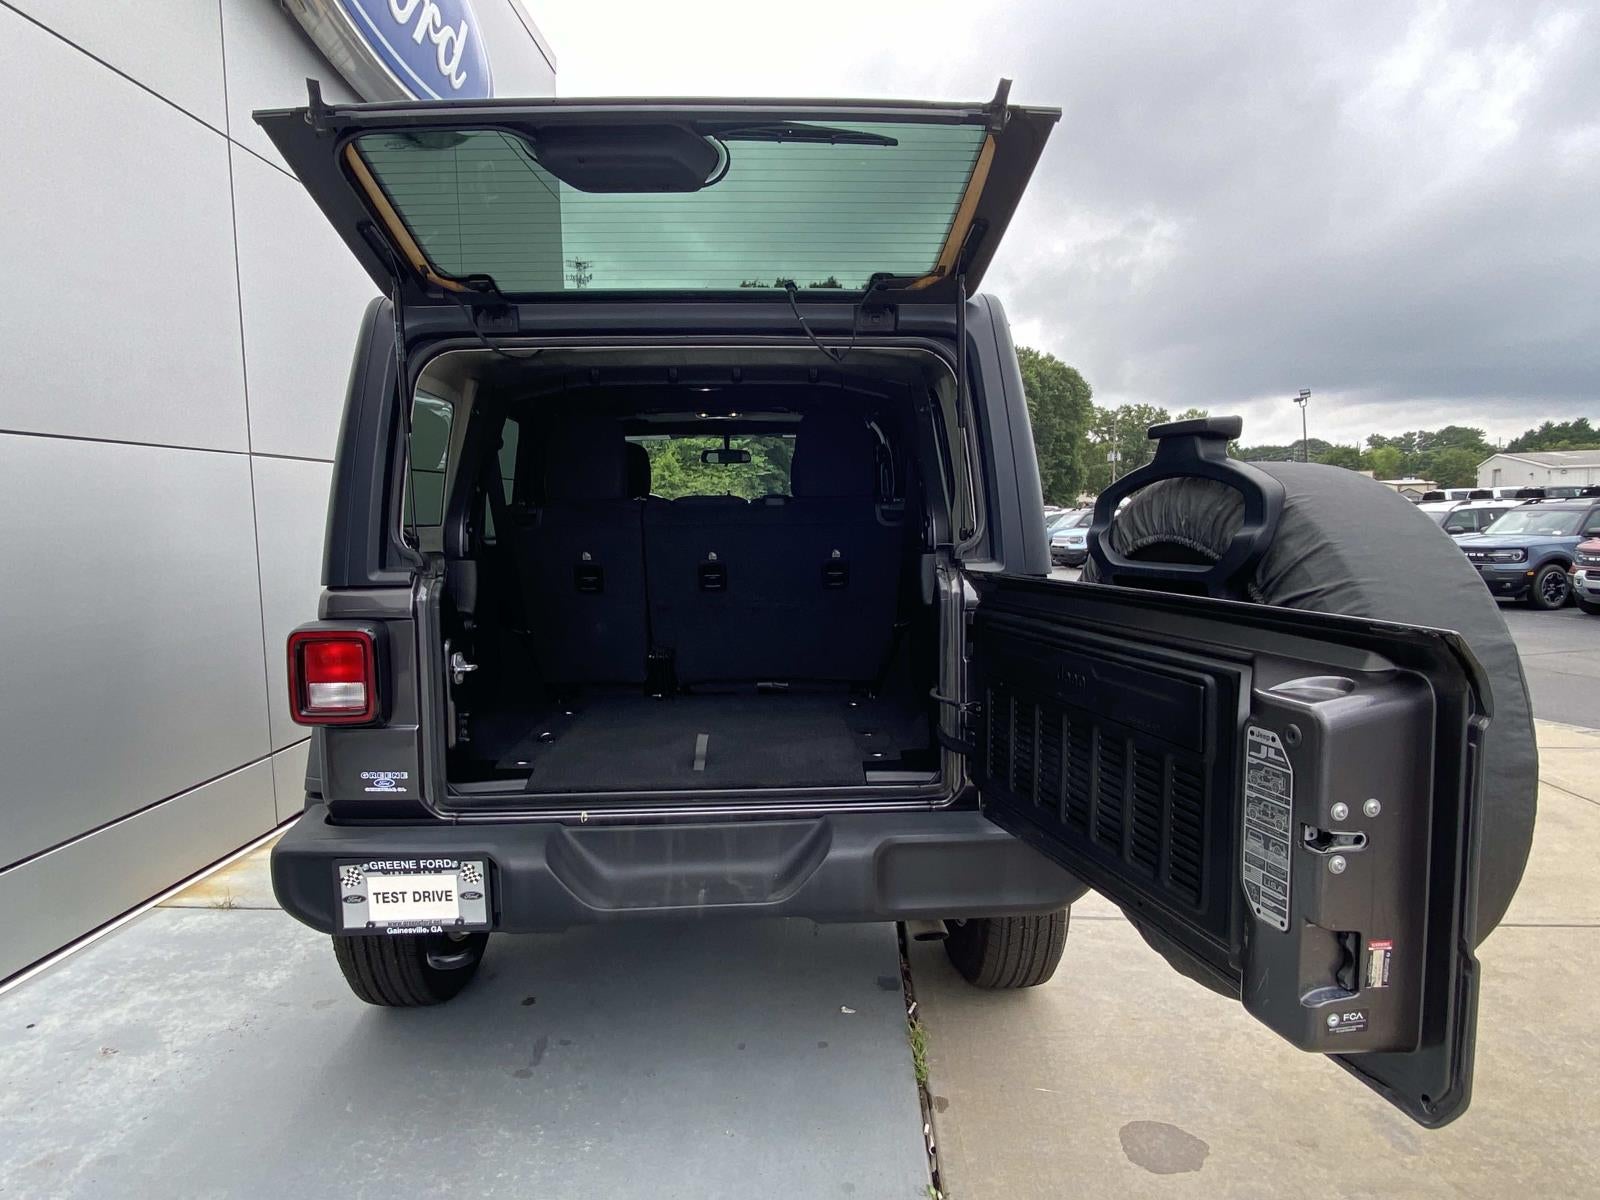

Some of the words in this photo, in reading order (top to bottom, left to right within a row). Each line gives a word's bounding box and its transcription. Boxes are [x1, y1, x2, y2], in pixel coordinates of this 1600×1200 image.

[387, 0, 468, 90] ord
[360, 771, 408, 779] GREENE
[369, 860, 417, 870] GREENE
[420, 859, 452, 869] FORD
[373, 891, 407, 904] TEST
[412, 890, 453, 903] DRIVE
[431, 925, 443, 933] GA
[1343, 1012, 1363, 1022] FCA
